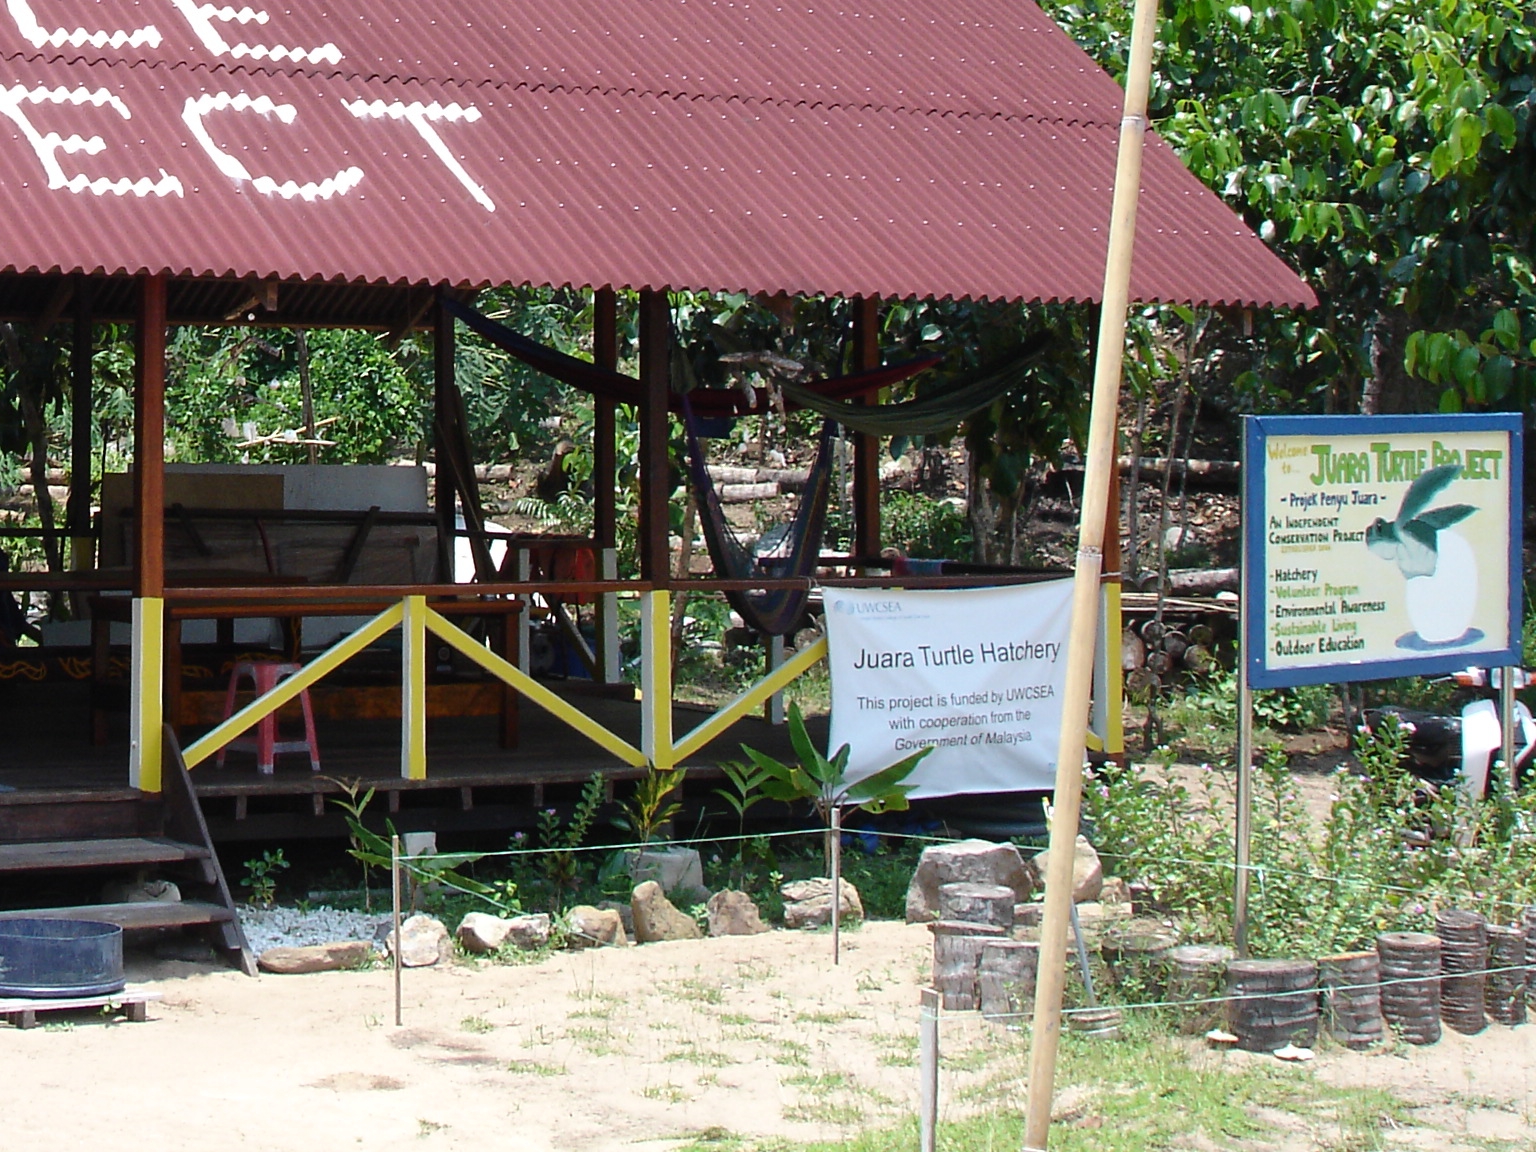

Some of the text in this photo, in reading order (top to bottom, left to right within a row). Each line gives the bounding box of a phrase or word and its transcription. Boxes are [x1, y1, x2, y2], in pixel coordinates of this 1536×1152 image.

[1267, 442, 1307, 460] Welcome
[1309, 444, 1370, 486] JUARA
[1370, 442, 1427, 483] TURTLE
[1320, 492, 1348, 512] Penyu
[1351, 490, 1378, 505] Juara
[1269, 515, 1339, 529] AN INDEPENDENT
[1269, 529, 1365, 545] CONSERVATION PROJECT
[1324, 583, 1359, 599] Program
[855, 600, 902, 614] UWCSEA
[1341, 600, 1386, 614] Awareness
[1332, 618, 1357, 635] Living
[1318, 635, 1365, 653] Education
[854, 639, 1061, 669] Juara Turtle Hatchery
[857, 684, 1055, 711] This project is funded by UWCSEA
[889, 709, 1031, 730] with cooperation from the
[894, 729, 1032, 751] Government of Malaysia
